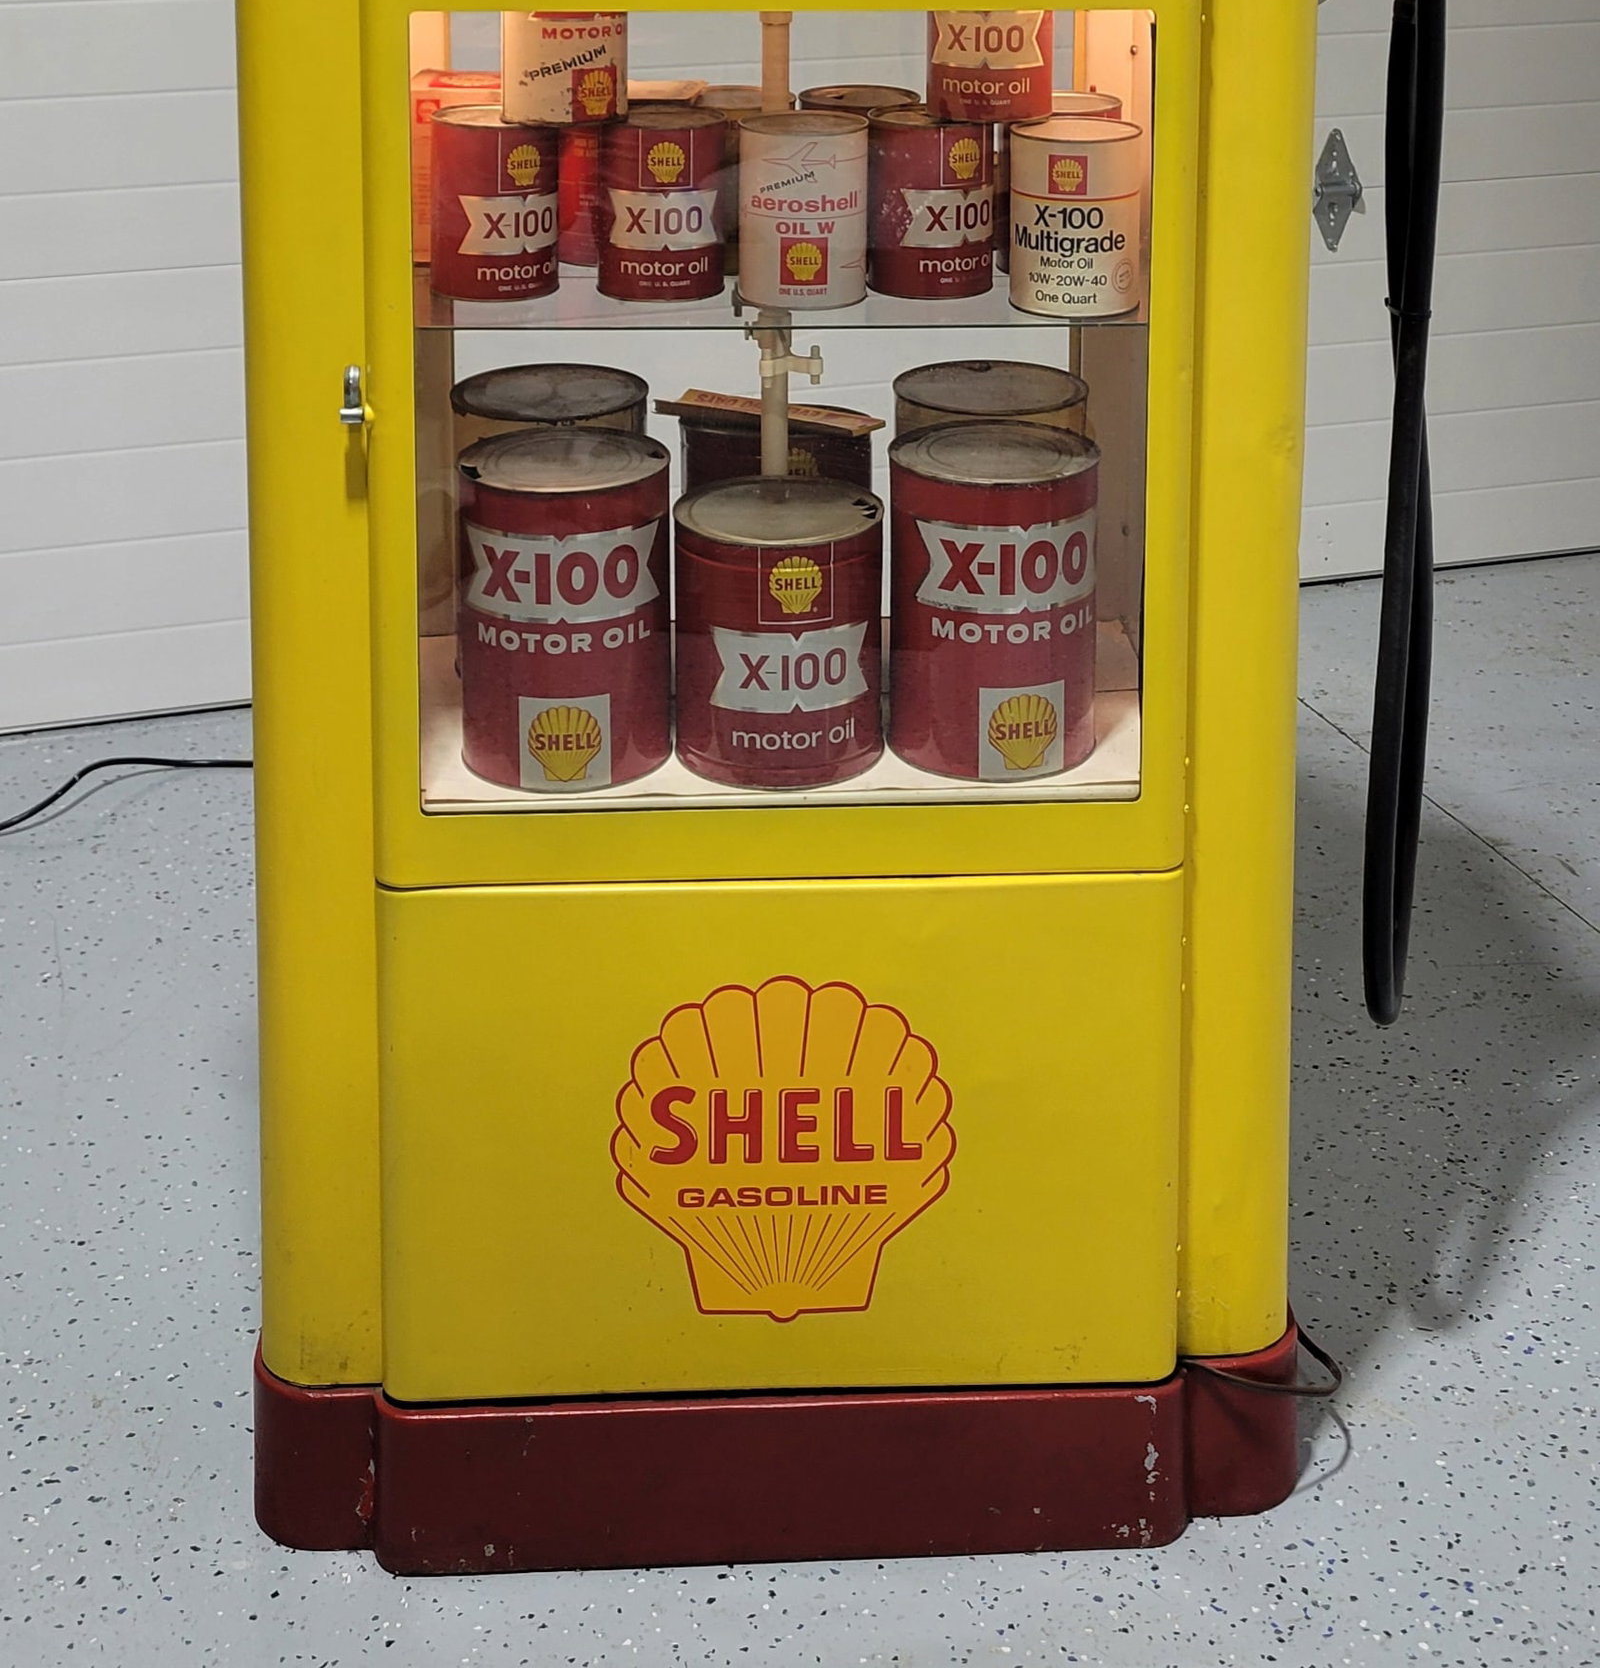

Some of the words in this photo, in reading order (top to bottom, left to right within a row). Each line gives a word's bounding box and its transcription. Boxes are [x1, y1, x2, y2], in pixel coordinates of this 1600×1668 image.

[541, 25, 612, 40] MOTOR
[947, 24, 1025, 53] X-100
[528, 44, 607, 81] PREMIUM
[943, 78, 1004, 95] motor
[1008, 77, 1030, 95] oil
[510, 158, 540, 171] SHELL
[650, 156, 682, 167] SHELL
[951, 152, 978, 164] SHELL
[759, 171, 815, 194] PREMIUM
[1054, 170, 1081, 180] SHELL
[751, 190, 858, 213] aeroshell
[483, 206, 552, 239] X-100
[625, 205, 703, 235] X-100
[926, 199, 990, 232] X-100
[1034, 203, 1104, 229] X-100
[775, 221, 811, 235] OIL
[817, 221, 836, 235] W
[1014, 223, 1126, 258] Multigrade
[477, 264, 541, 281] motor
[620, 260, 684, 276] motor
[687, 256, 709, 275] oil
[789, 256, 819, 266] SHELL
[919, 256, 979, 273] motor
[1039, 256, 1075, 269] Motor
[1076, 257, 1094, 269] Oil
[1028, 271, 1108, 287] 10W-20W-40
[1035, 289, 1060, 303] One
[1061, 292, 1098, 305] Quart
[481, 543, 640, 606] X-100
[937, 530, 1088, 596] X-100
[774, 576, 819, 592] SHELL
[931, 616, 1052, 645] MOTOR
[1059, 604, 1093, 634] OIL
[477, 622, 593, 655] MOTOR
[602, 619, 651, 650] OIL
[739, 647, 847, 691] X-100
[732, 730, 823, 751] motor
[828, 717, 856, 744] oil
[994, 718, 1053, 741] SHELL
[534, 733, 596, 751] SHELL
[649, 1085, 923, 1165] SHELL
[677, 1184, 888, 1208] GASOLINE
